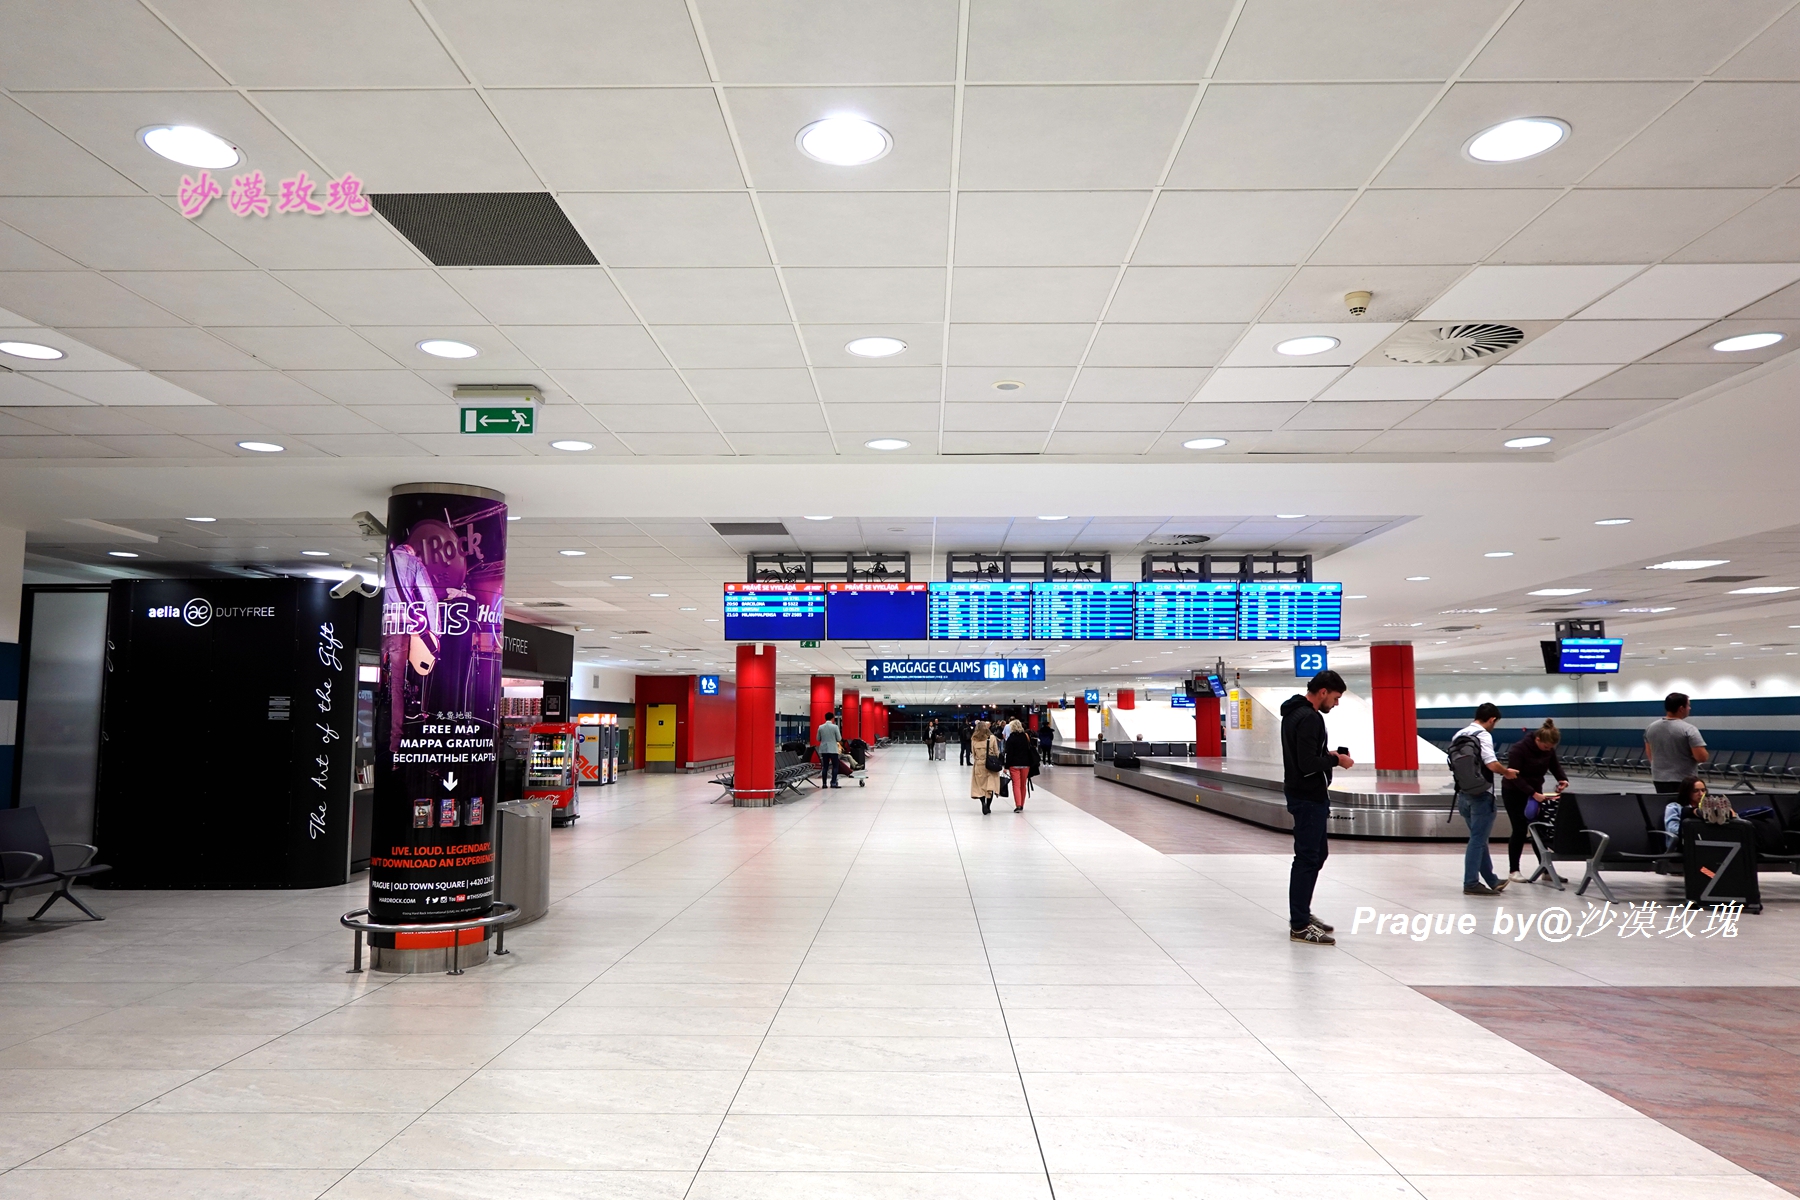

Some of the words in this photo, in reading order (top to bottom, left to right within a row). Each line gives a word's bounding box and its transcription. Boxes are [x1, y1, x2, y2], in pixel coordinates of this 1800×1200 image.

[148, 605, 181, 618] aelia
[216, 607, 275, 617] DUTYFREE
[318, 622, 343, 672] Gift
[882, 661, 936, 674] BAGGAGE
[939, 661, 980, 674] CLAIMS
[1300, 654, 1322, 670] 23
[315, 678, 332, 713] the
[1086, 692, 1098, 701] 24
[316, 722, 340, 743] of
[422, 725, 452, 734] FREE
[454, 724, 481, 734] MAP
[400, 739, 443, 748] MAPPA
[446, 738, 494, 748] GRATUITA
[393, 753, 469, 763] БЕСПЛАТНЫЕ
[471, 752, 497, 762] КАРТЫ
[311, 754, 329, 790] Art
[309, 801, 326, 840] The
[391, 846, 412, 856] LIVE.
[414, 846, 444, 856] LOUD.
[446, 842, 491, 855] LEGENDARY.
[382, 858, 437, 869] DOWNLOAD
[439, 858, 454, 868] AN
[393, 882, 409, 891] OLD
[409, 882, 434, 891] TOWN
[435, 880, 465, 891] SQUARE
